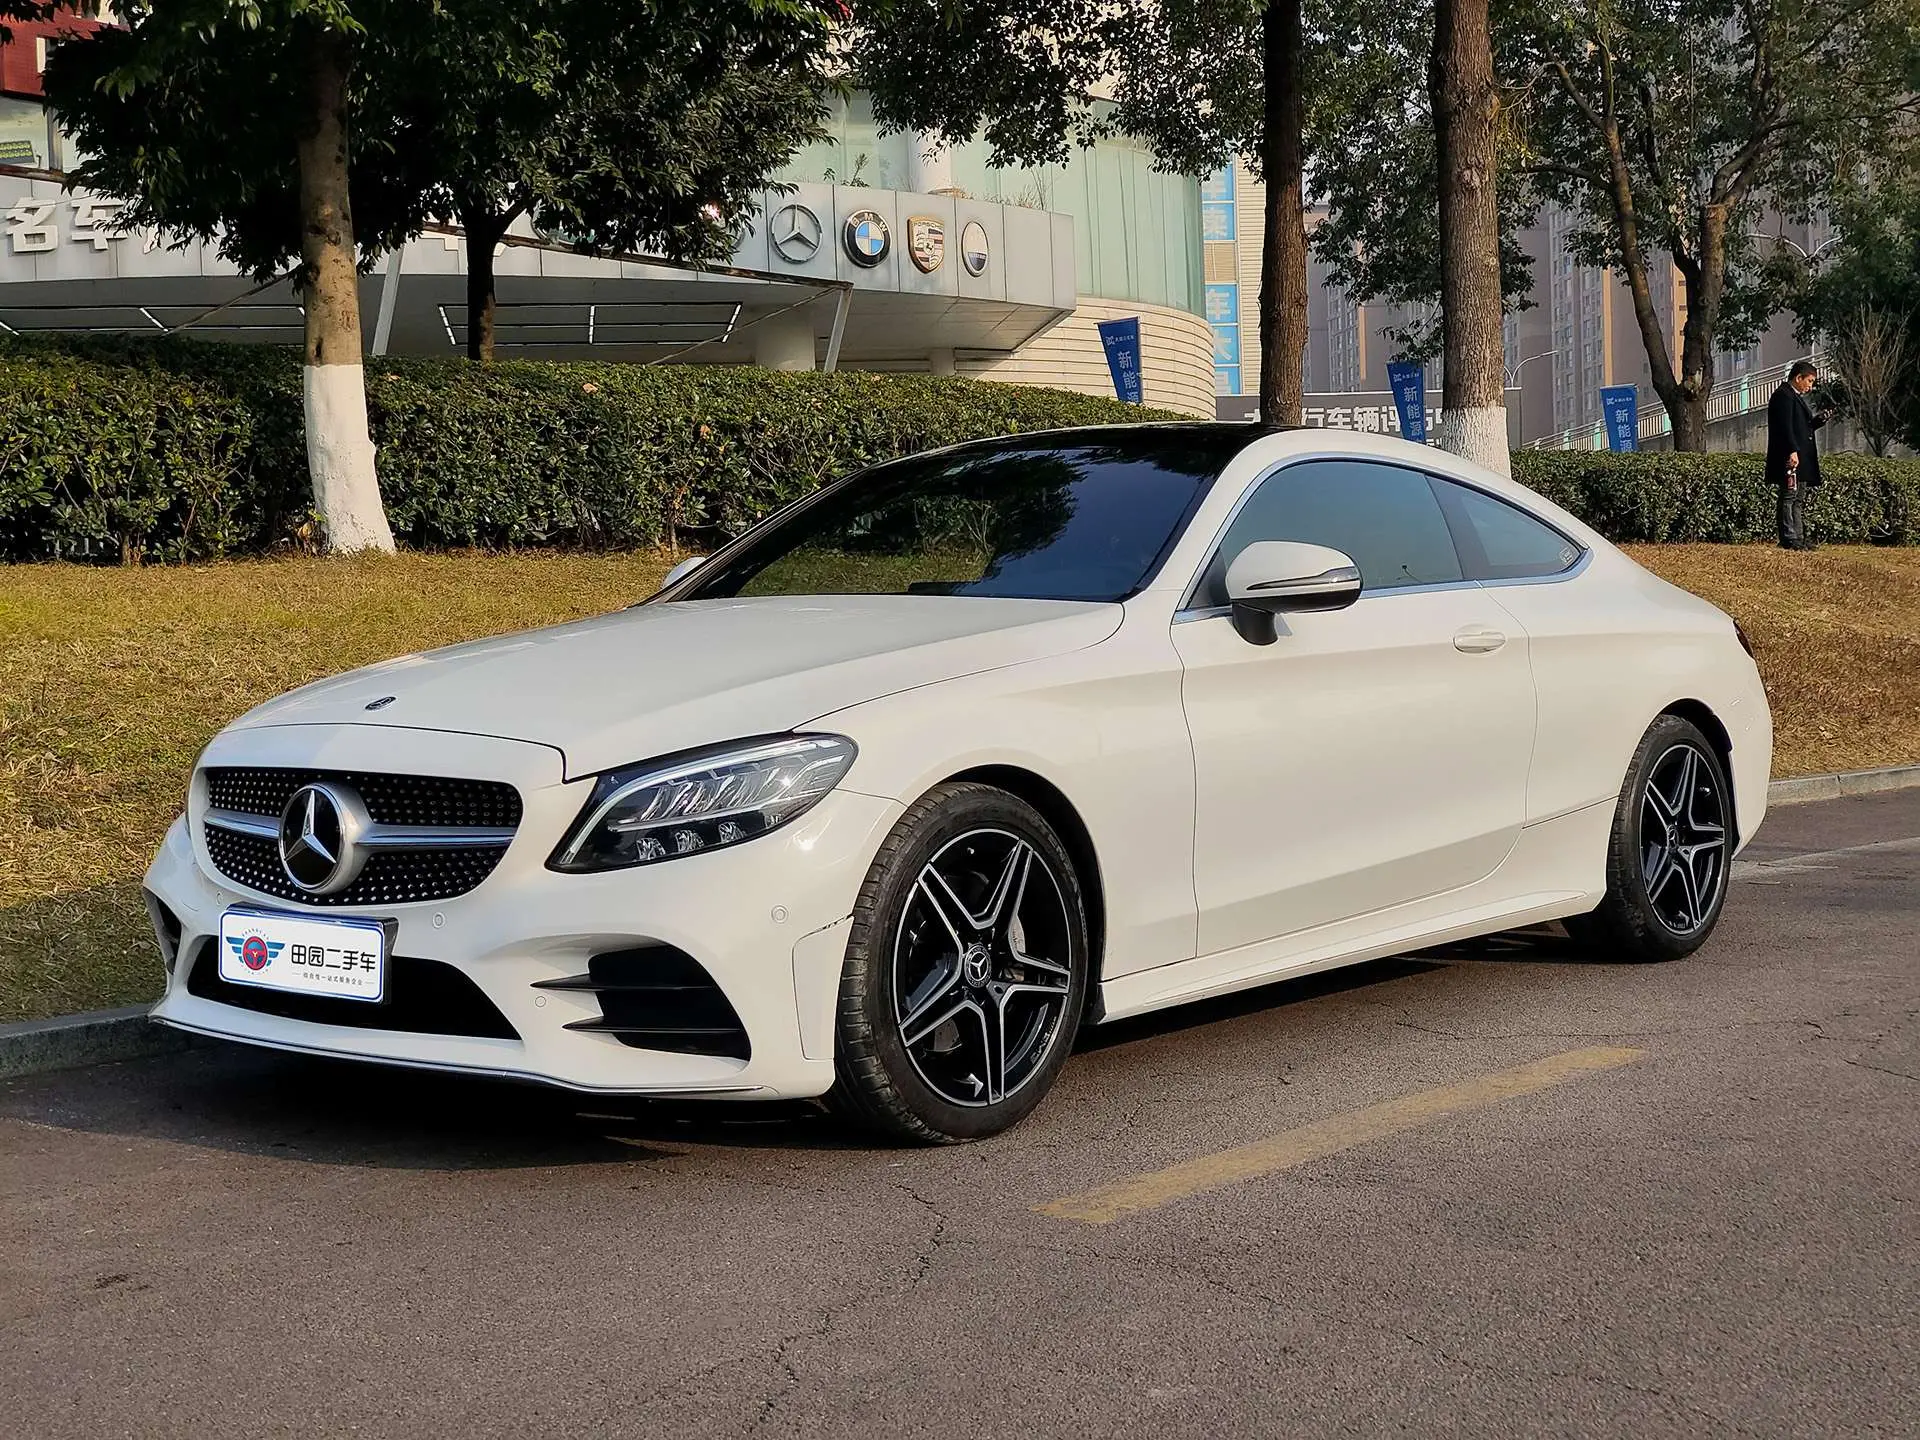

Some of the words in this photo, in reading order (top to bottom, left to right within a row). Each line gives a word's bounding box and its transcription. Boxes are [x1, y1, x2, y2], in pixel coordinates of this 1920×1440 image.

[850, 212, 888, 232] BMW
[291, 944, 377, 973] 田园二手车
